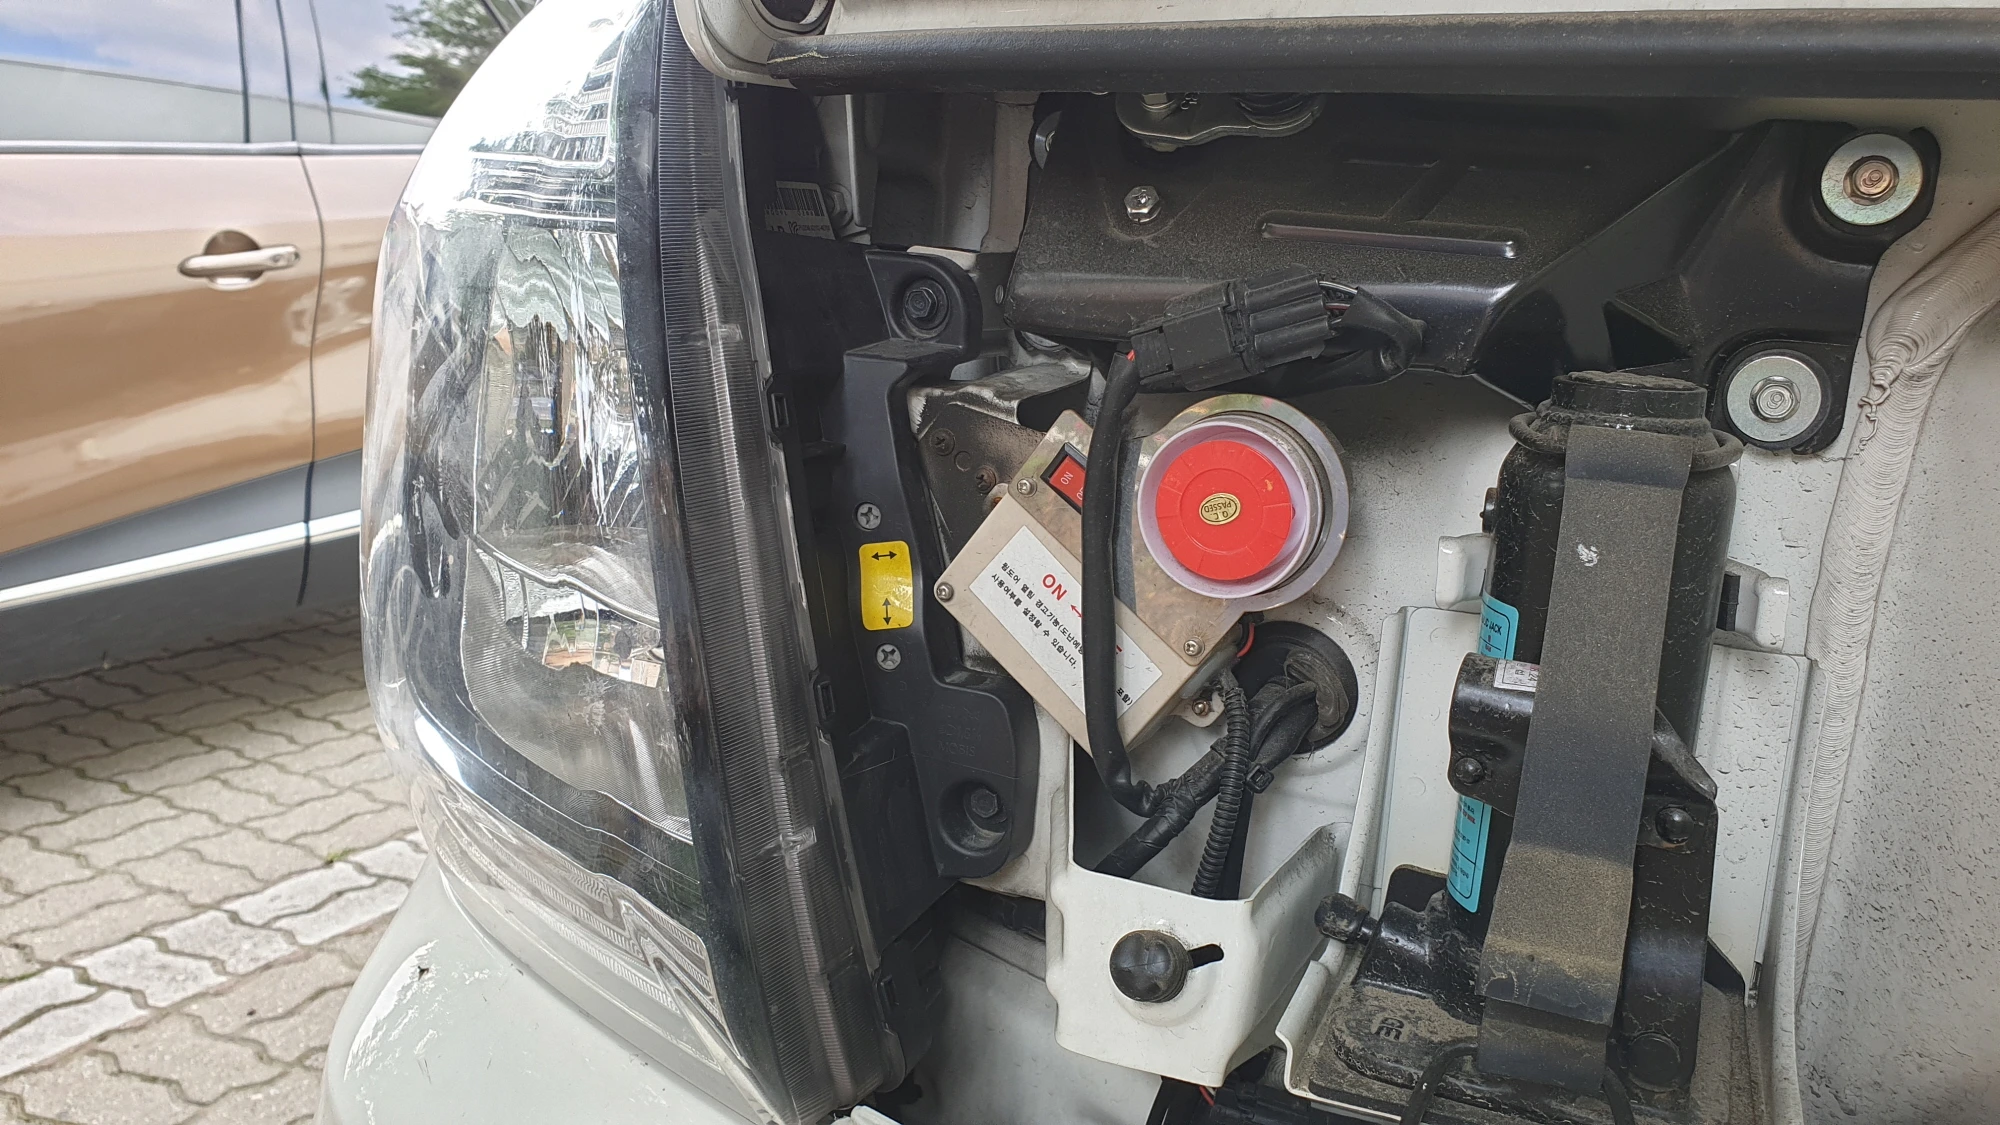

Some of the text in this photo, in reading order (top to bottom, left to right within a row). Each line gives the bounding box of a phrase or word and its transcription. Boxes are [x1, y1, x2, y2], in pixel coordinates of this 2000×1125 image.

[1060, 471, 1074, 485] ON
[1203, 500, 1232, 513] PASSED
[1020, 583, 1036, 600] 열림
[1042, 573, 1067, 601] ON
[991, 573, 1077, 670] 사용여부를 설정할 수 있습니다.
